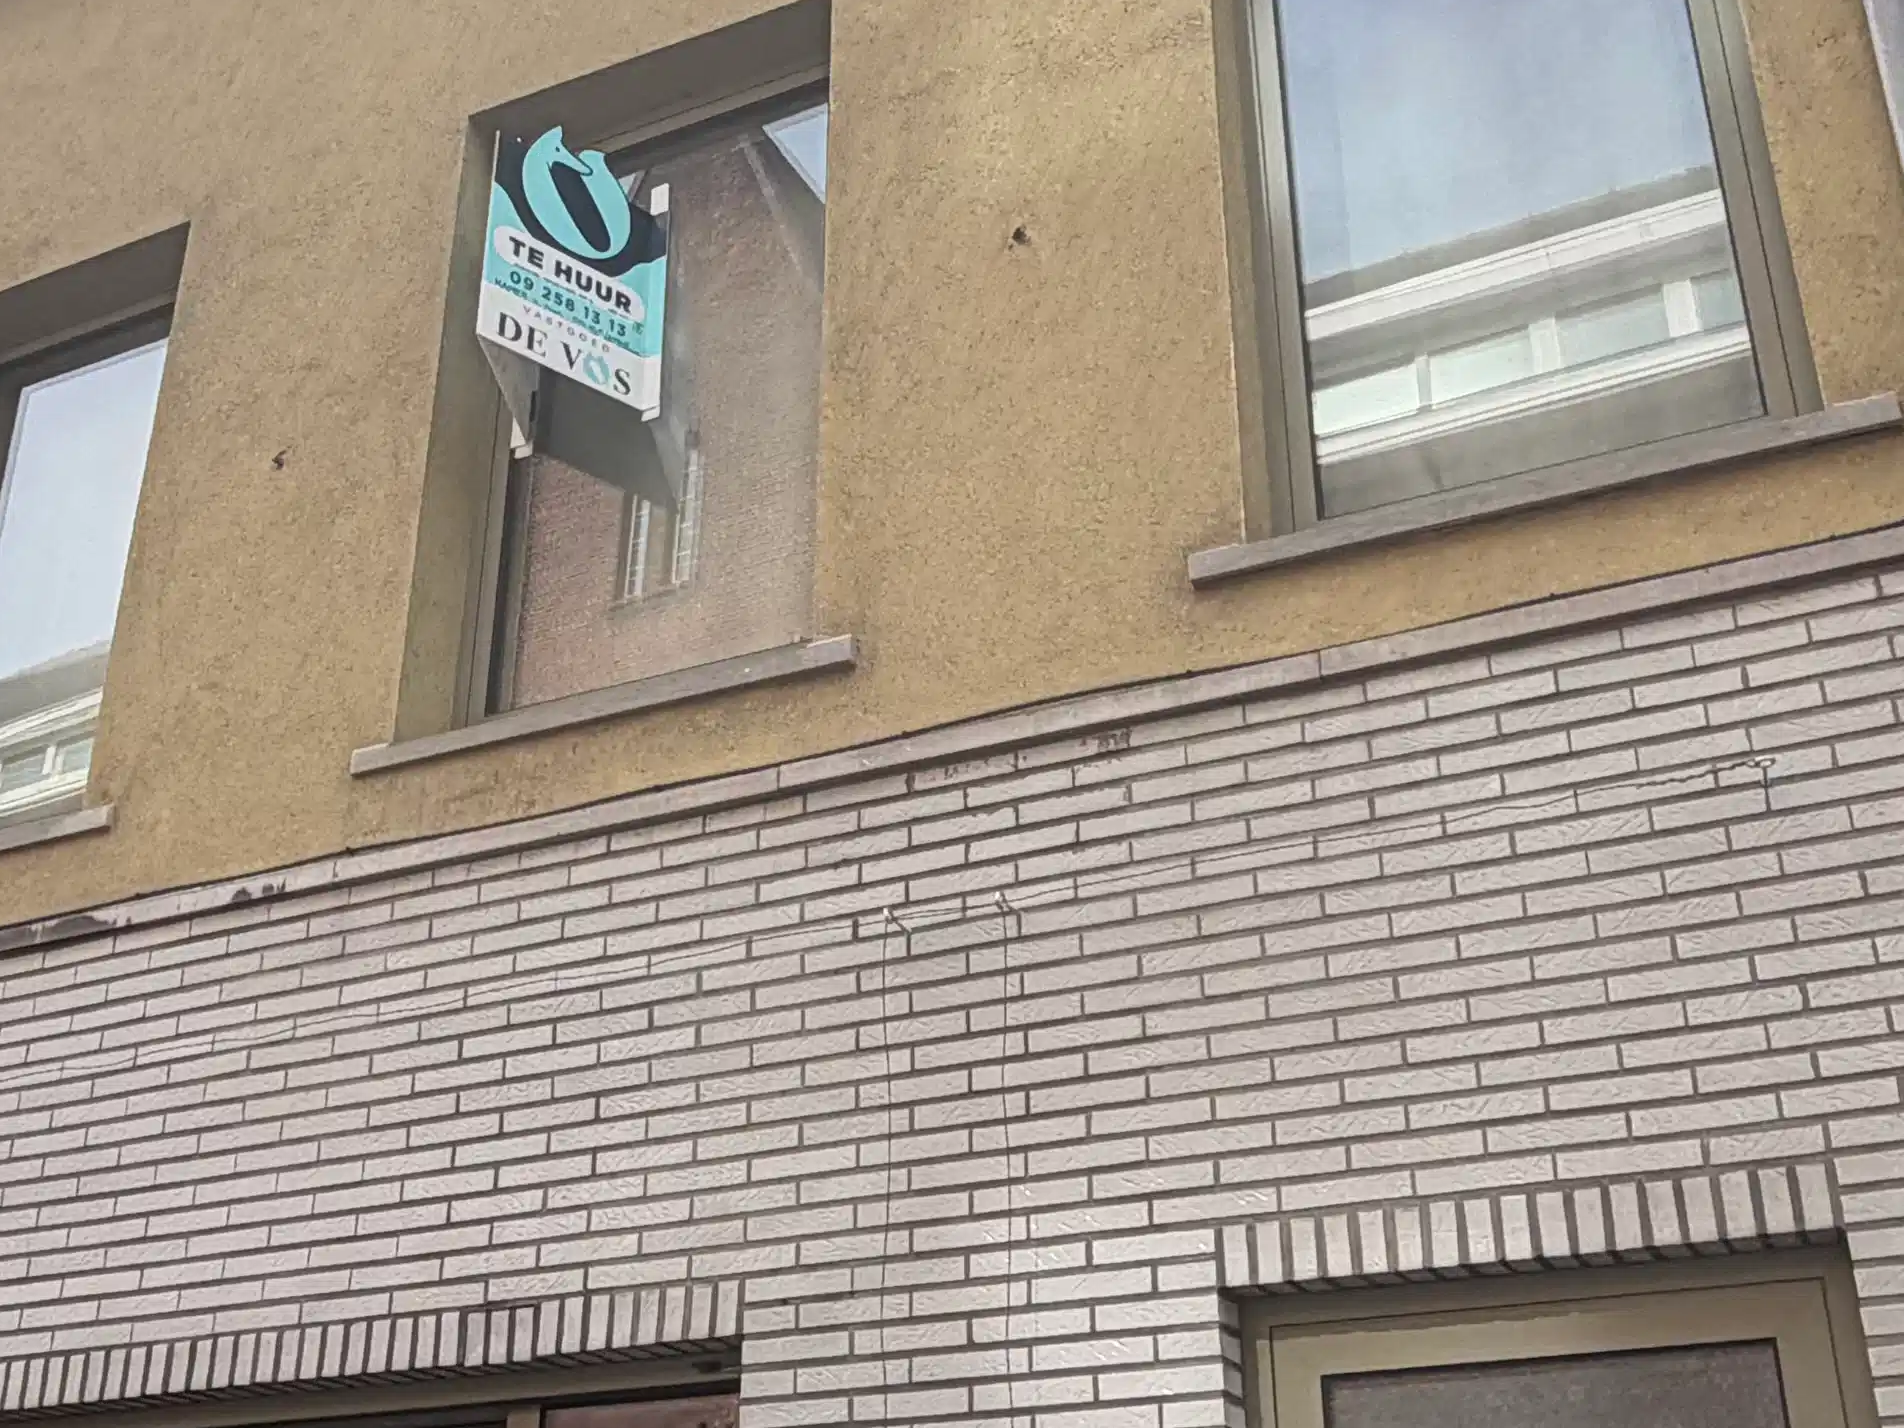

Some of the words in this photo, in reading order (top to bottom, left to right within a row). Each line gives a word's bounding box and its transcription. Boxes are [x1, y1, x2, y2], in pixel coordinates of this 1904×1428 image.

[508, 235, 545, 270] TE
[553, 259, 632, 315] HUUR
[509, 270, 534, 292] 09
[540, 285, 576, 313] 258
[583, 305, 601, 326] 13
[608, 318, 627, 338] 13
[497, 311, 549, 359] DE
[559, 339, 632, 396] VOS
